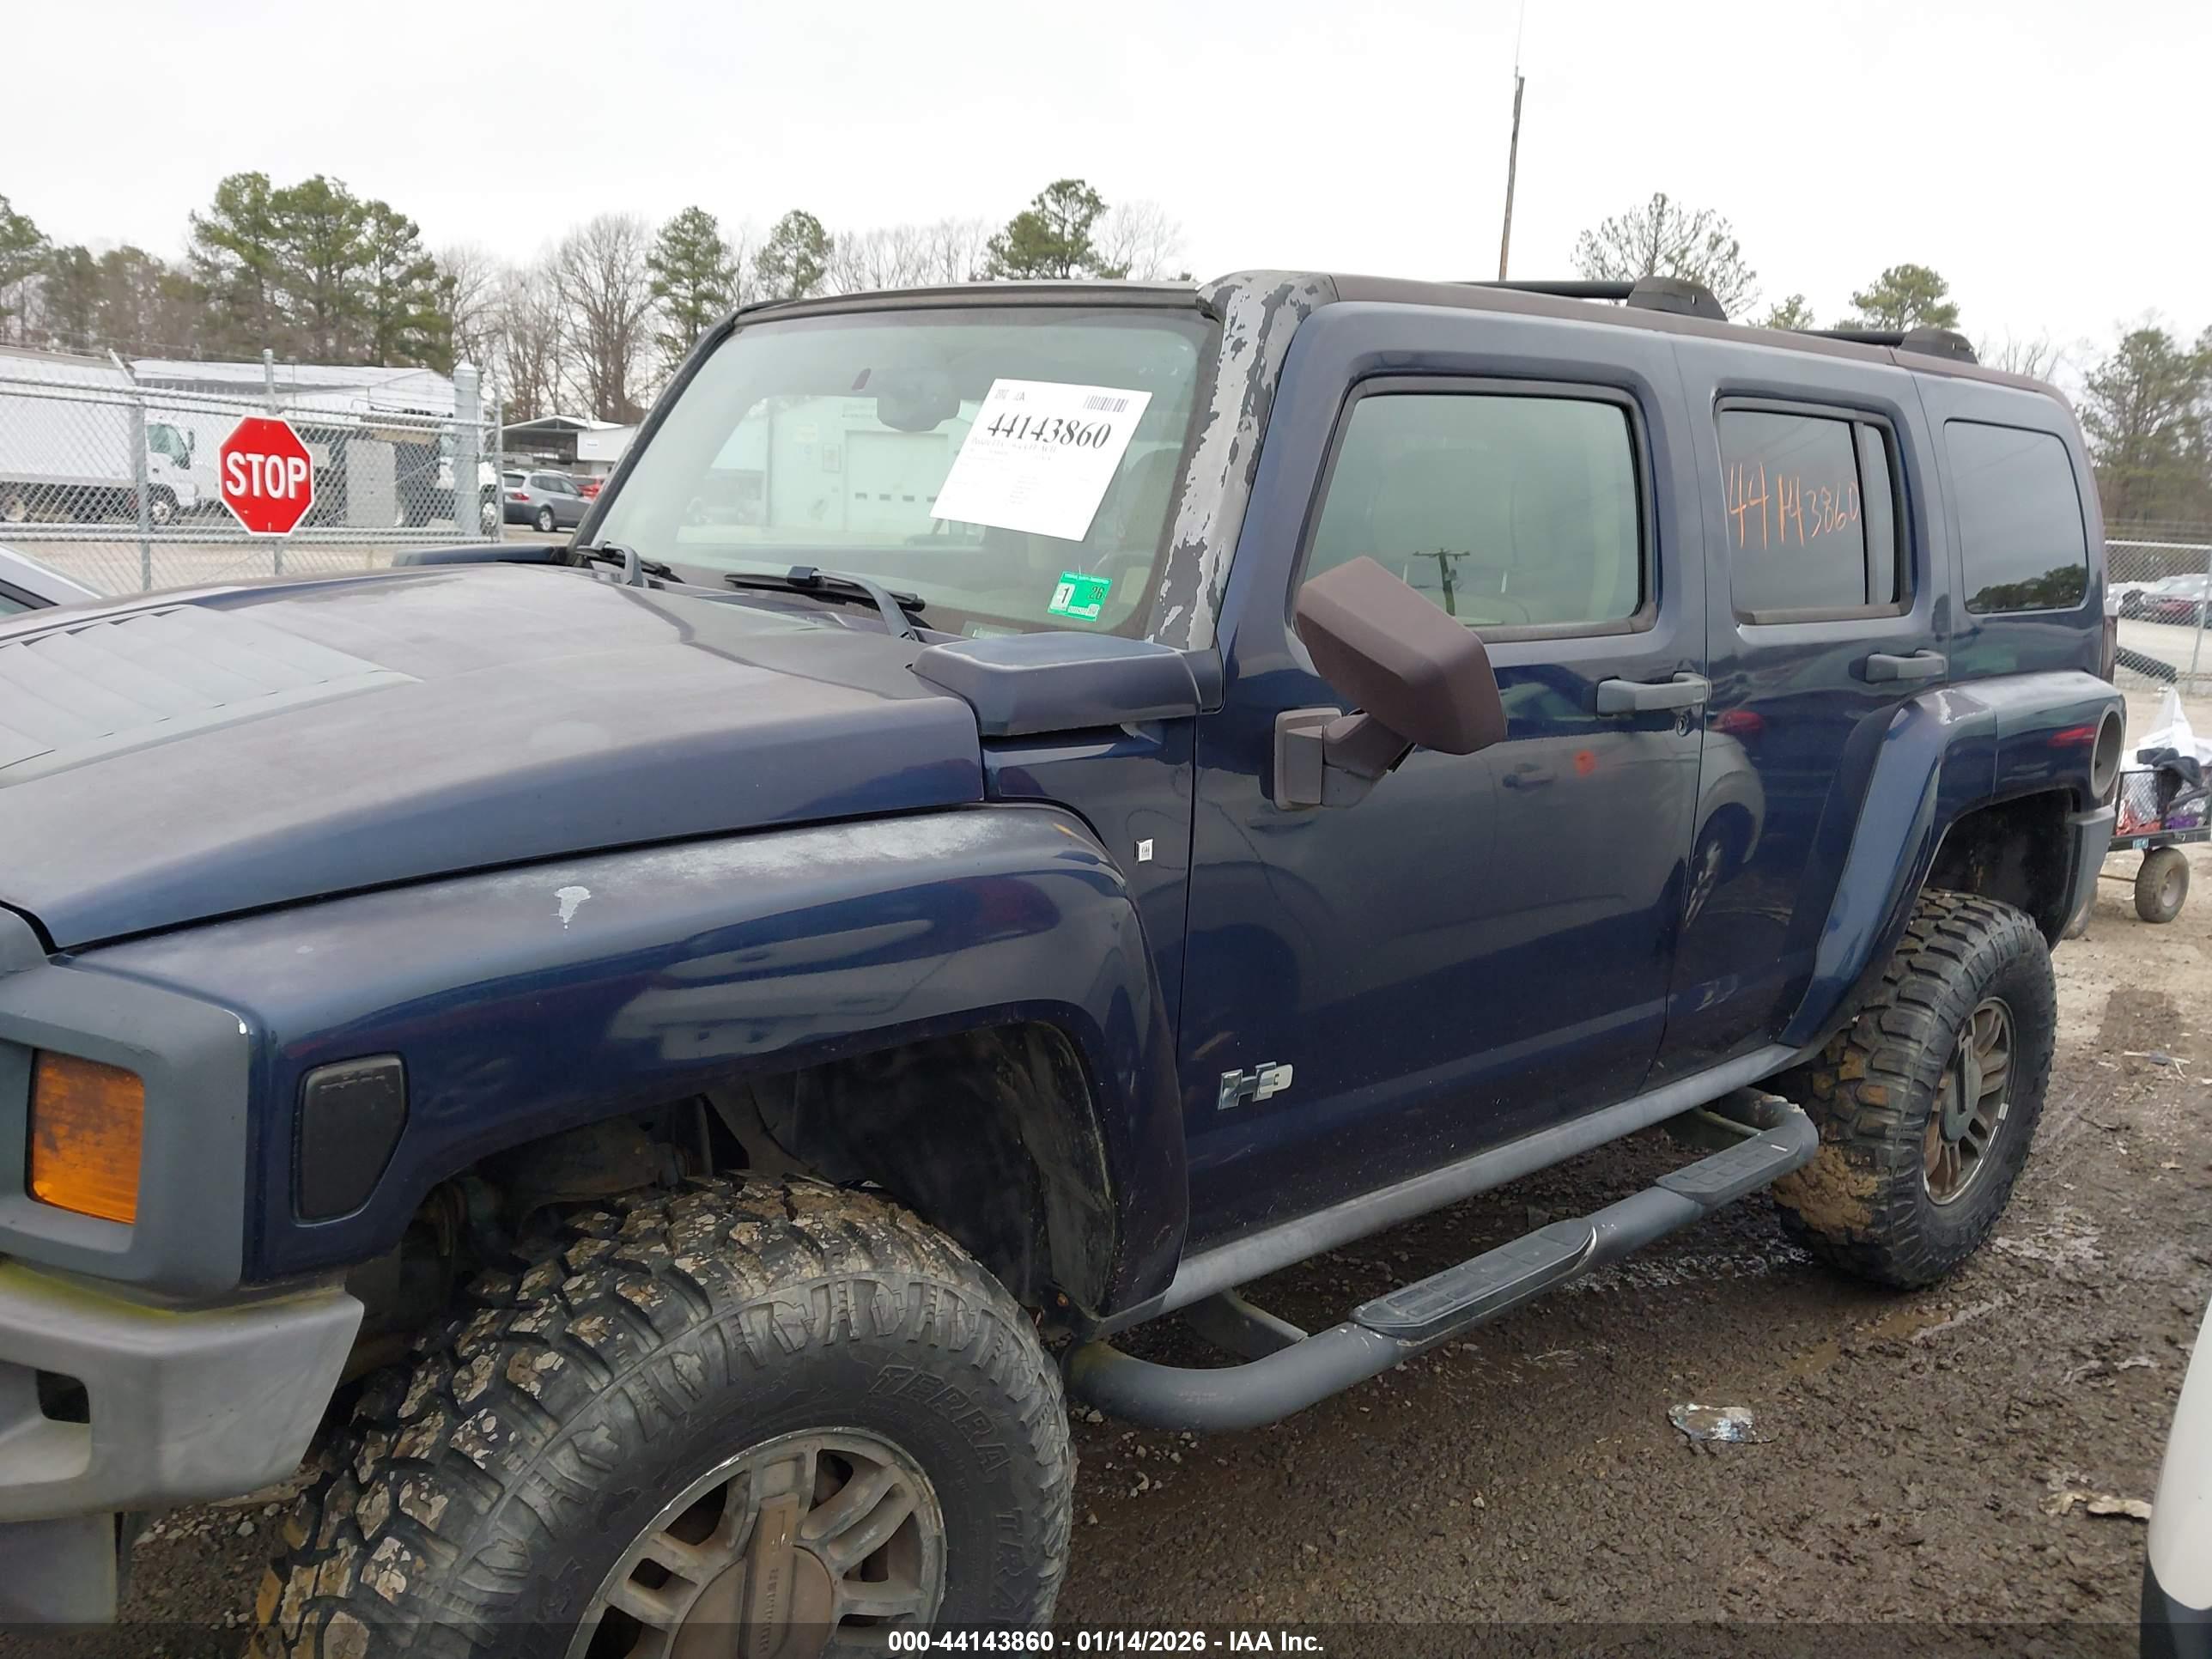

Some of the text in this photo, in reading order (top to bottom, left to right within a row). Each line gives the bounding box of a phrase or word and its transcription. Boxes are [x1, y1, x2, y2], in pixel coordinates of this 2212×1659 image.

[988, 412, 1111, 449] 44143860
[226, 451, 307, 499] STOP
[867, 1364, 1012, 1486] TERRA
